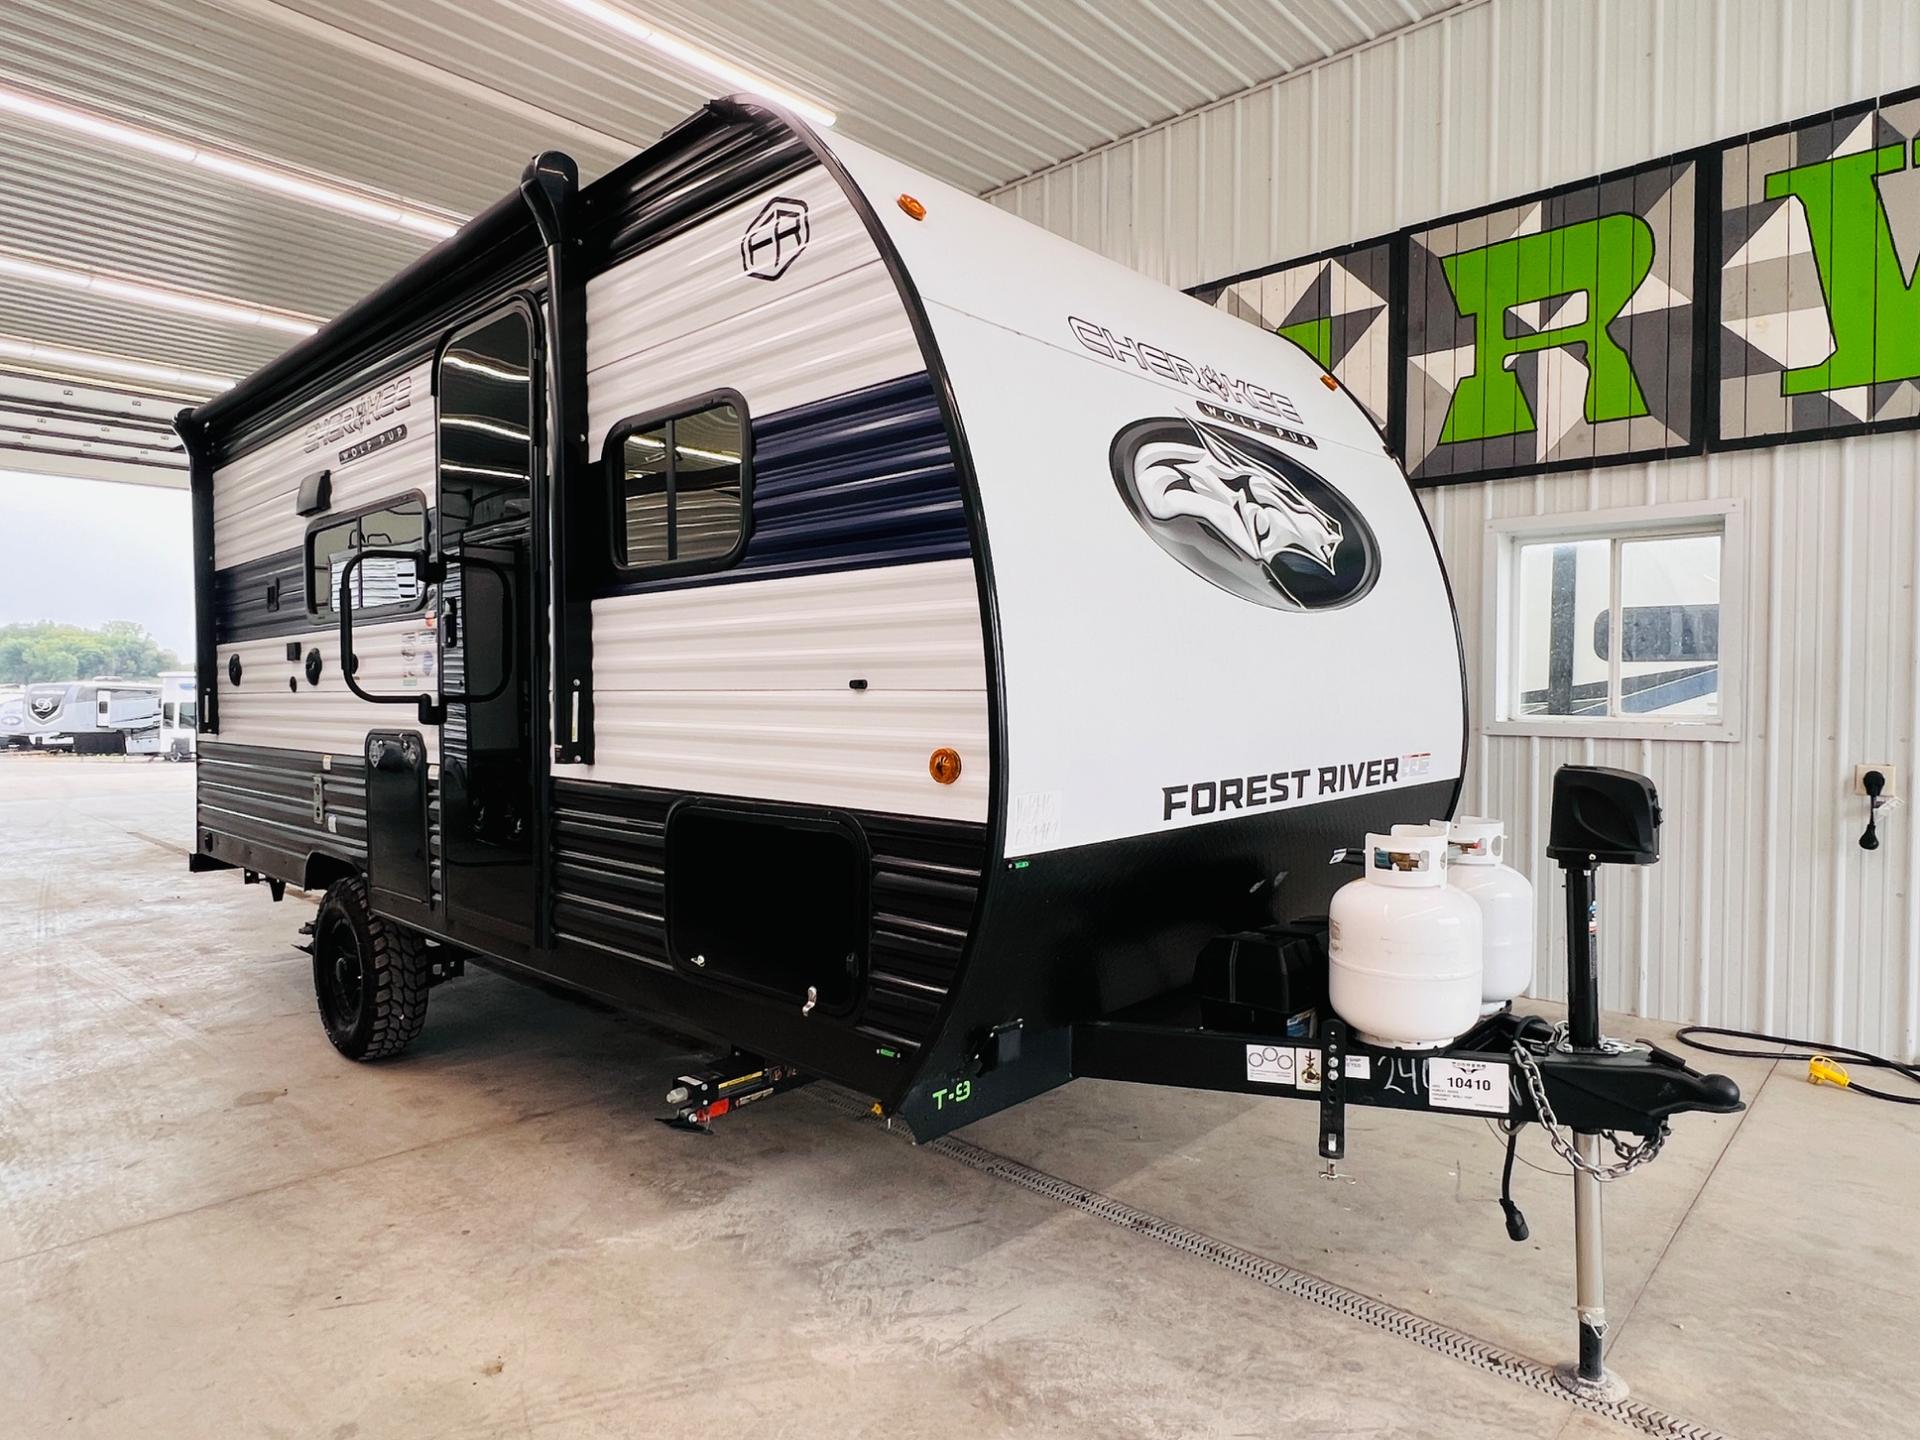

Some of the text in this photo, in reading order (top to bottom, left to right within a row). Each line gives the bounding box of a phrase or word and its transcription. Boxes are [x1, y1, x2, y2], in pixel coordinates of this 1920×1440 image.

[341, 427, 403, 461] WOLF PUP
[1204, 404, 1311, 446] WOLF PUP
[1161, 768, 1311, 821] FOREST
[1318, 757, 1399, 796] RIVER
[1446, 1076, 1491, 1091] 10410
